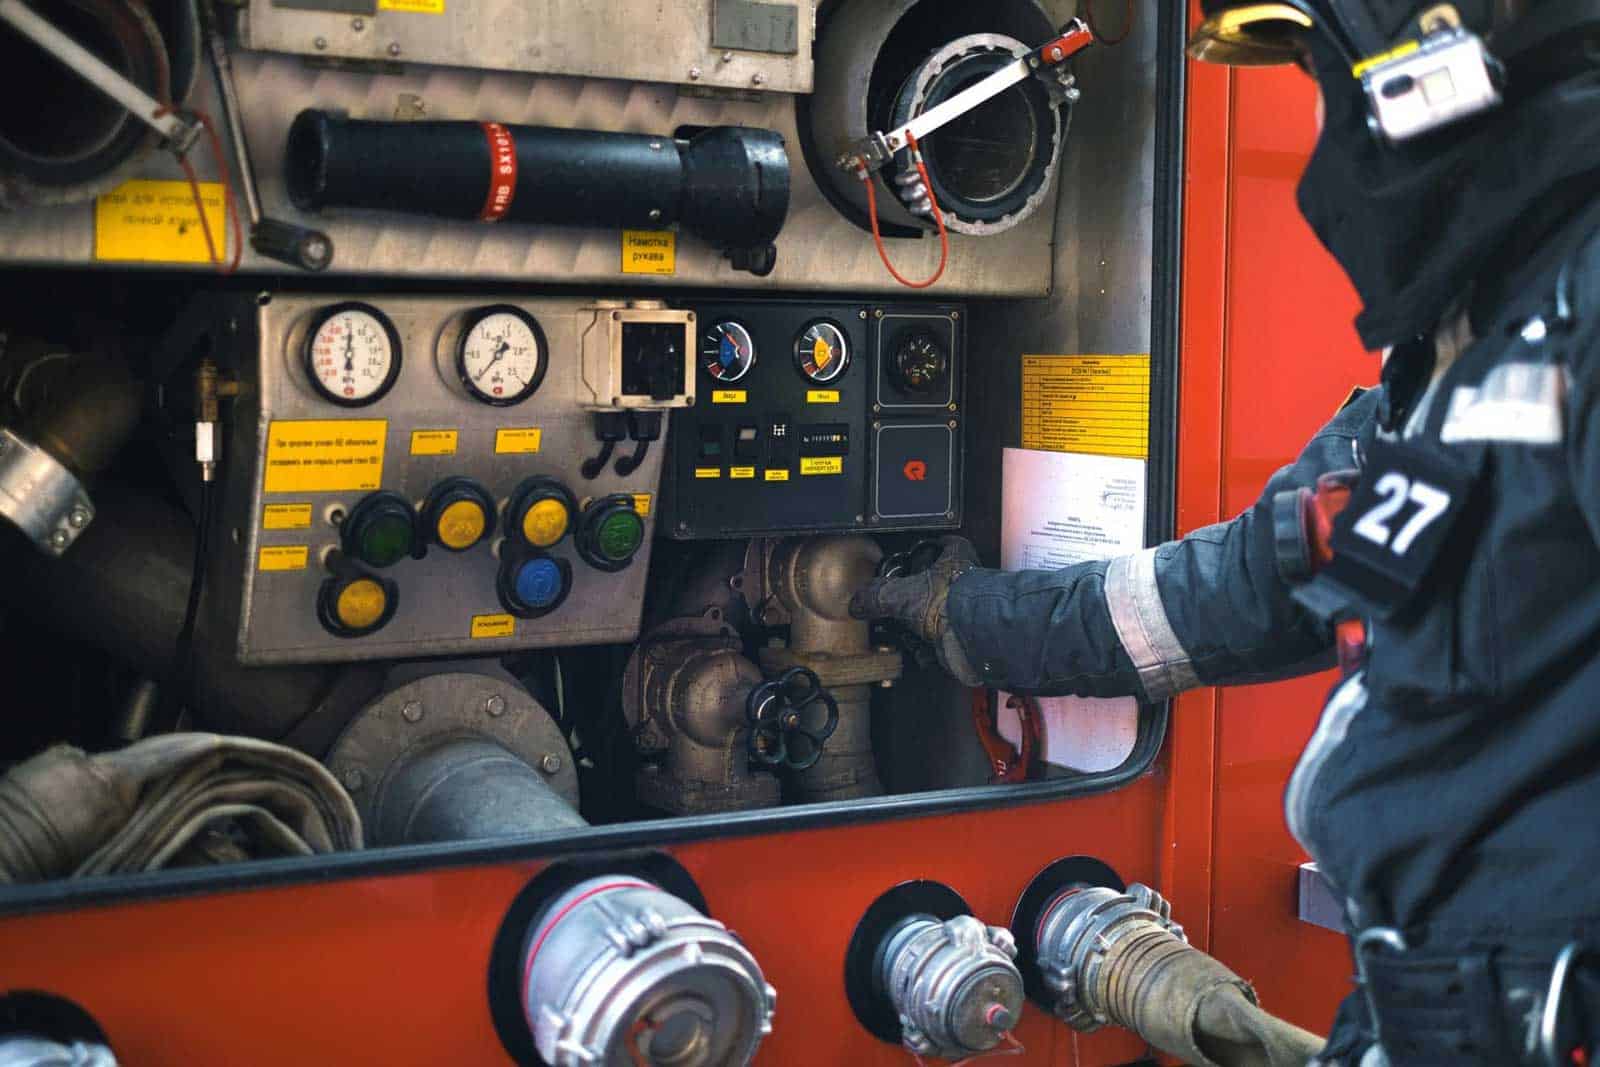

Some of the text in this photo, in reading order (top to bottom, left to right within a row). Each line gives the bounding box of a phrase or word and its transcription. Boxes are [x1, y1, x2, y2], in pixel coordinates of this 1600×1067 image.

[629, 236, 669, 248] Намотка
[633, 252, 665, 264] рукава
[1353, 473, 1450, 554] 27
